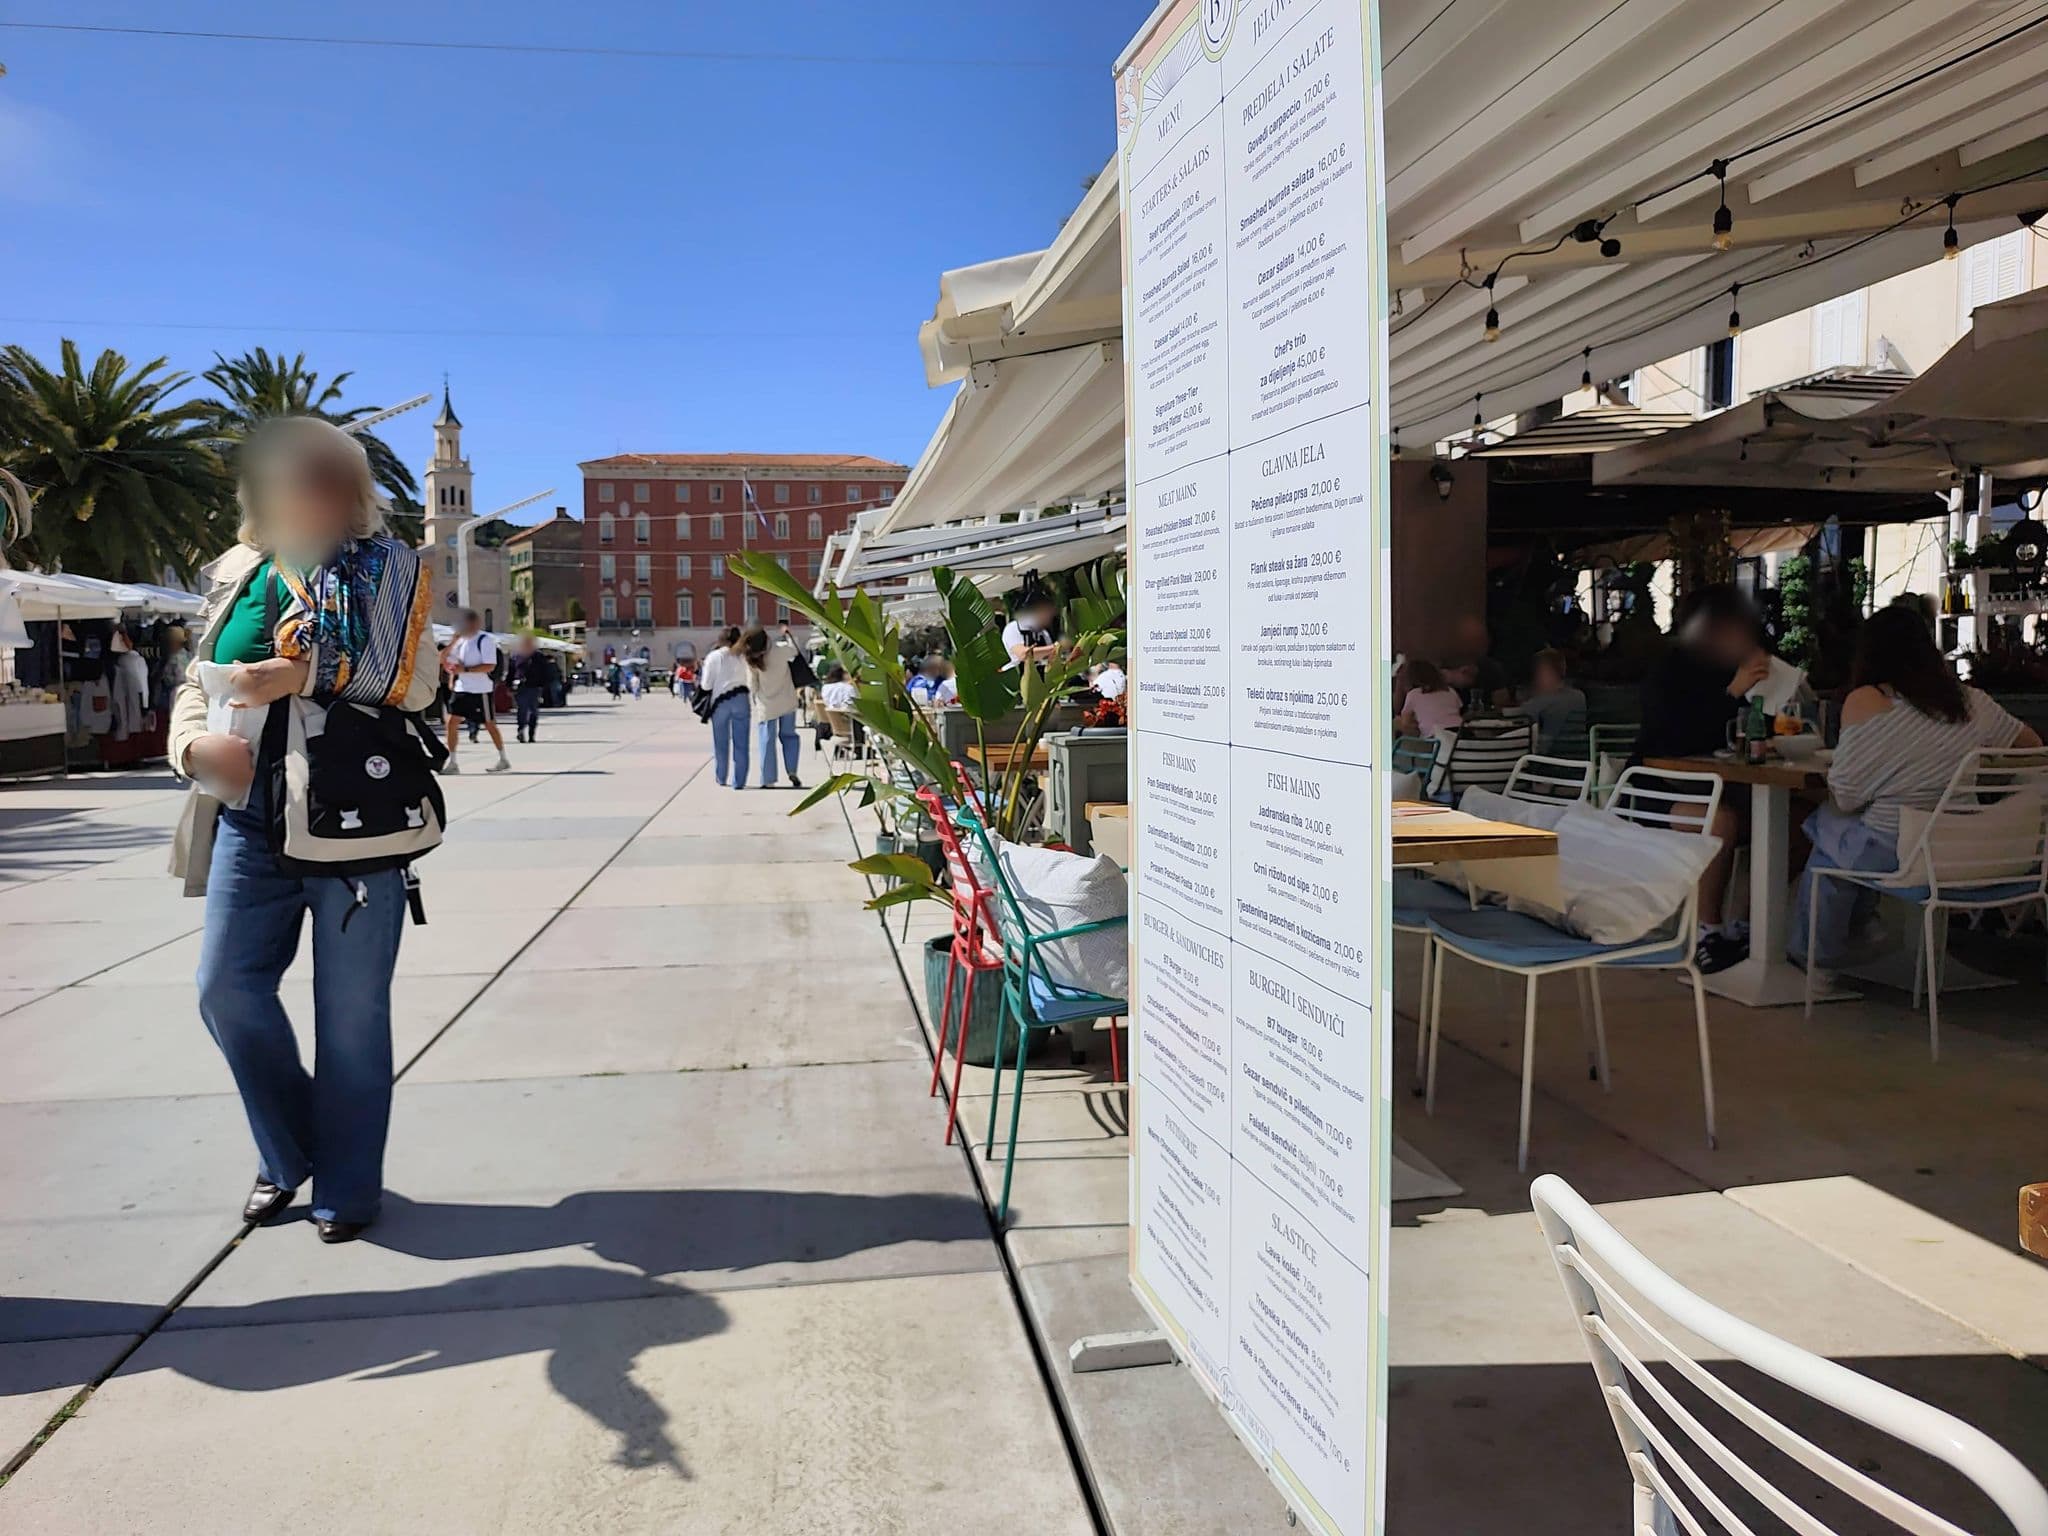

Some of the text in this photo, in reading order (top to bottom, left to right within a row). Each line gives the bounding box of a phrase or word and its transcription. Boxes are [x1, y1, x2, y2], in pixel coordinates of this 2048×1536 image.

[1252, 0, 1291, 45] JELO
[1242, 26, 1334, 125] PREDJELA I SALATE
[1157, 99, 1182, 141] MENU
[1268, 72, 1330, 135] carpaccio 17,00 €
[1178, 144, 1209, 183] SALADS
[1239, 141, 1345, 231] Smashed burrata salata 16,00 €
[1207, 241, 1213, 255] €
[1257, 231, 1325, 285] Cezar salata 14,00 €
[1293, 331, 1306, 348] trio
[1259, 345, 1325, 387] za dijeljenje 45,00 €
[1197, 401, 1203, 414] €
[1261, 442, 1325, 477] GLAVNA JELA
[1250, 496, 1273, 511] Pečena
[1293, 486, 1308, 504] prsa
[1310, 478, 1332, 497] 21,00
[1333, 476, 1340, 491] €
[1348, 492, 1363, 505] umak
[1250, 549, 1341, 574] Flank steak sa žara 29,00 €
[1282, 625, 1298, 639] rump
[1300, 621, 1320, 637] 32,00
[1321, 621, 1328, 636] €
[1325, 641, 1347, 651] salatom
[1347, 641, 1355, 651] od
[1246, 686, 1265, 700] Teleći
[1265, 687, 1283, 701] obraz
[1288, 689, 1314, 705] njokima
[1316, 691, 1339, 707] 25,00
[1340, 692, 1348, 707] €
[1267, 771, 1320, 800] FISH MAINS
[1258, 804, 1290, 823] Jadranska
[1304, 816, 1324, 834] 24,00
[1324, 822, 1331, 836] €
[1253, 861, 1338, 904] Crni rižoto od sipe 21,00 €
[1236, 897, 1268, 920] Tjestenina
[1268, 912, 1295, 933] paccheri
[1300, 924, 1331, 951] kozicama
[1333, 940, 1355, 960] 21,00
[1355, 949, 1363, 964] €
[1249, 969, 1290, 1004] BURGERI
[1291, 991, 1295, 1008] I
[1297, 995, 1344, 1037] SENDVIČI
[1266, 1015, 1275, 1030] B7
[1276, 1020, 1298, 1044] burger
[1317, 1048, 1323, 1062] €
[1242, 1062, 1261, 1083] Cezar
[1293, 1098, 1323, 1129] piletinom
[1325, 1121, 1344, 1145] 17,00
[1345, 1135, 1352, 1150] €
[1336, 1183, 1343, 1198] €
[1271, 1212, 1317, 1267] SLASTICE
